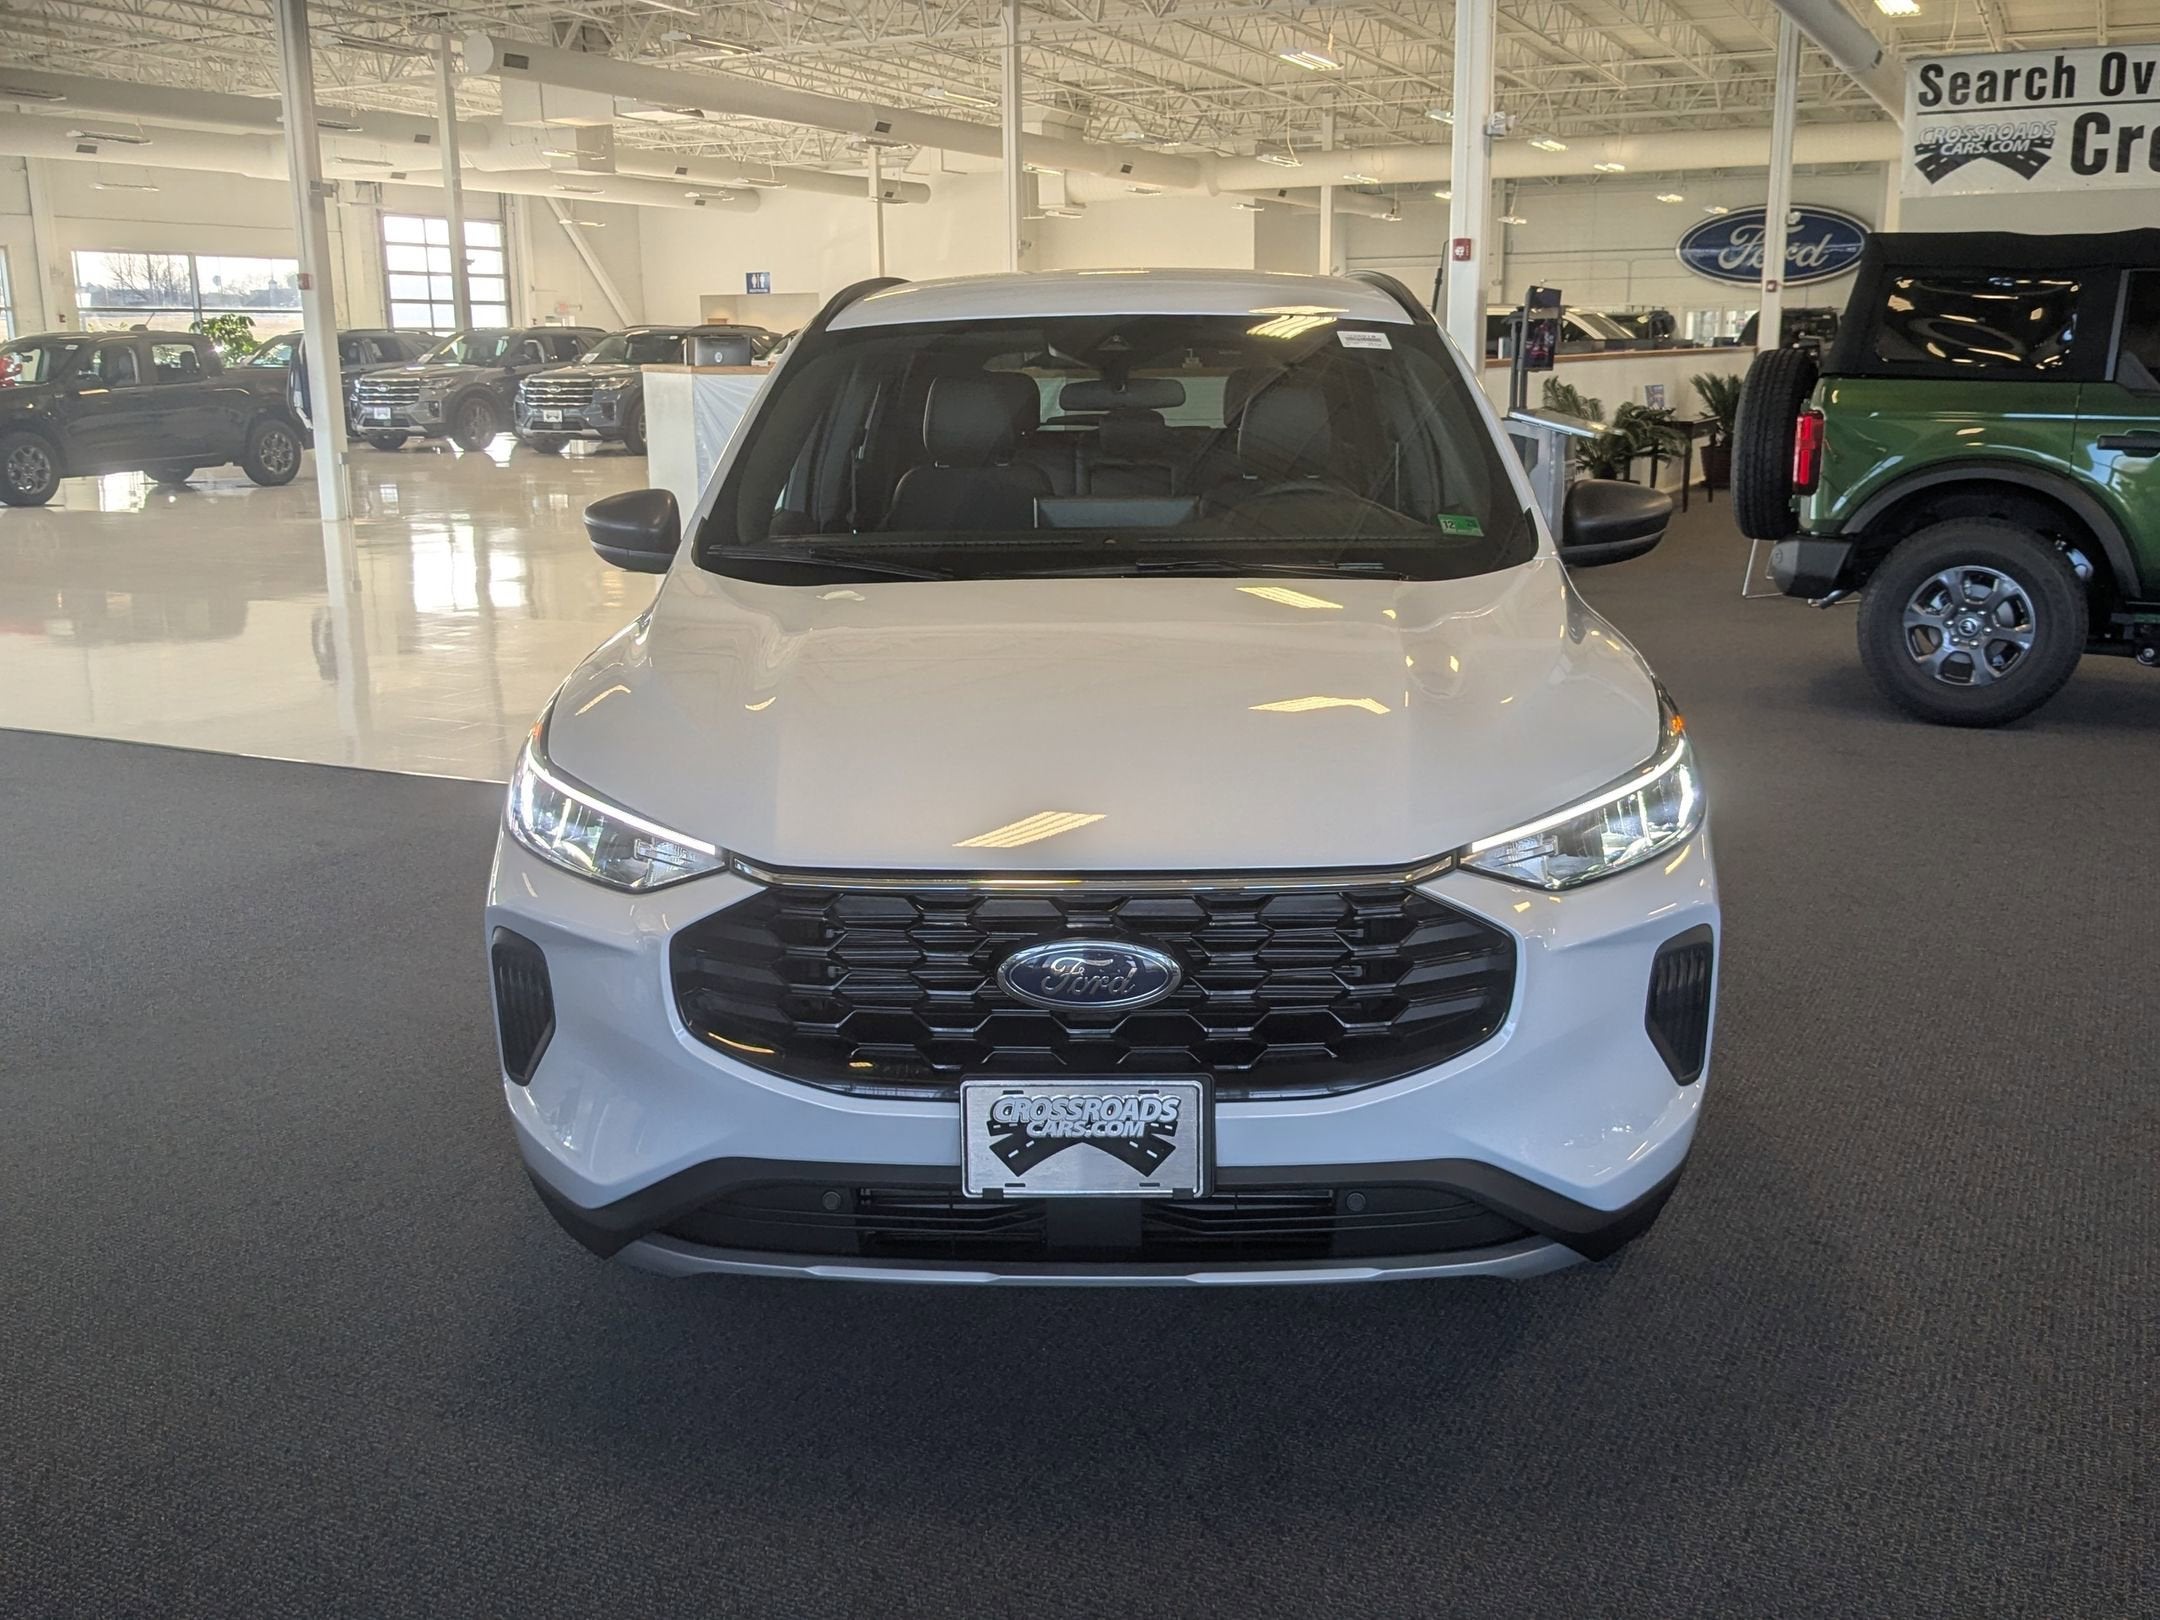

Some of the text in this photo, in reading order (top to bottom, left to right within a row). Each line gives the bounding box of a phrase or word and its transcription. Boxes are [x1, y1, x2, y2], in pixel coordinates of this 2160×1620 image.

[1918, 52, 2160, 107] Search Ov
[1919, 121, 2058, 145] CROSSROADS
[1940, 139, 2031, 155] CARS.COM
[1443, 520, 1456, 529] 12
[1041, 956, 1138, 996] Ford
[991, 1095, 1182, 1123] CROSSROADS
[1026, 1120, 1147, 1138] CARS.COM
